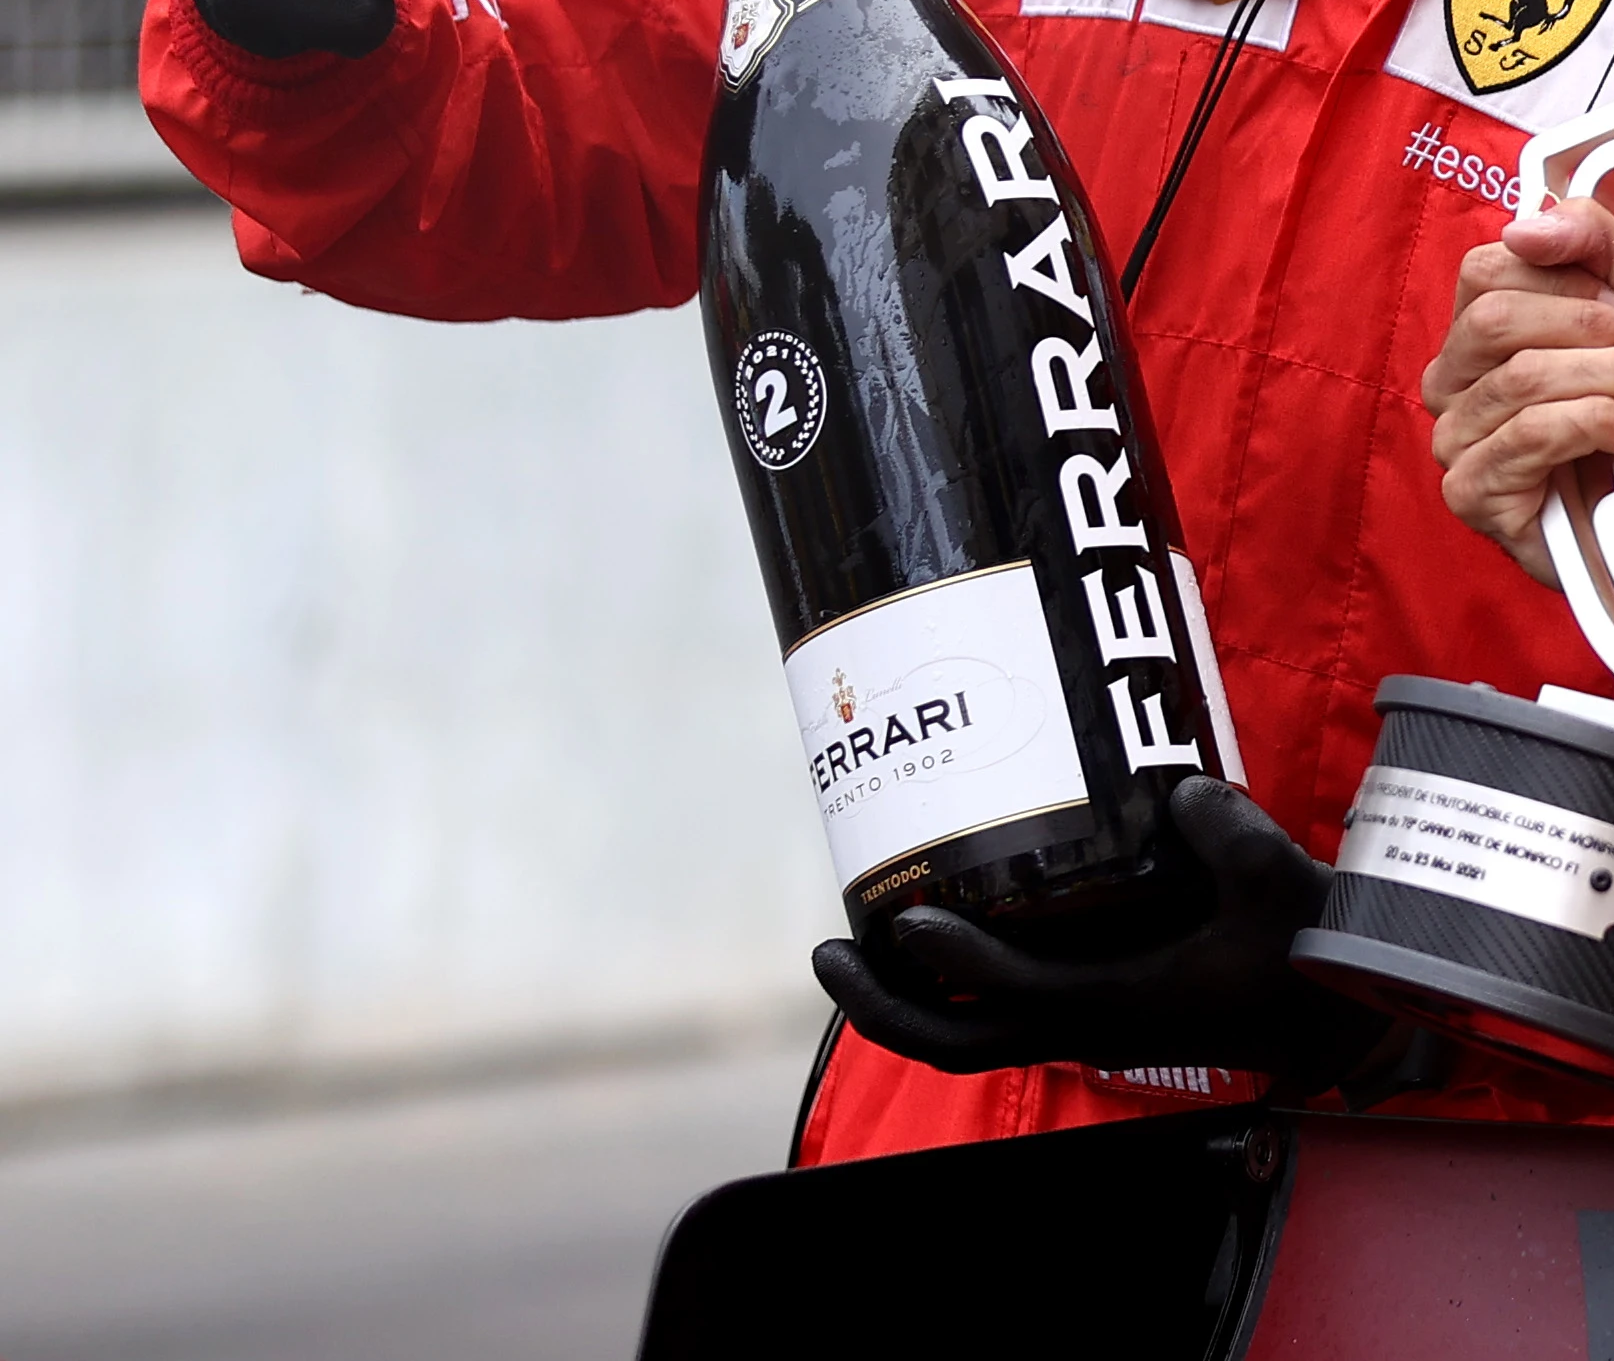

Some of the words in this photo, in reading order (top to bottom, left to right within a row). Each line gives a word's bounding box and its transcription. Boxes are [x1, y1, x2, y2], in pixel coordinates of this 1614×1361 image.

[754, 368, 799, 439] 2
[933, 75, 1204, 777] FERRARI
[823, 776, 883, 822] TRENTO
[892, 748, 956, 783] 1902
[860, 860, 932, 906] TRENTODOC
